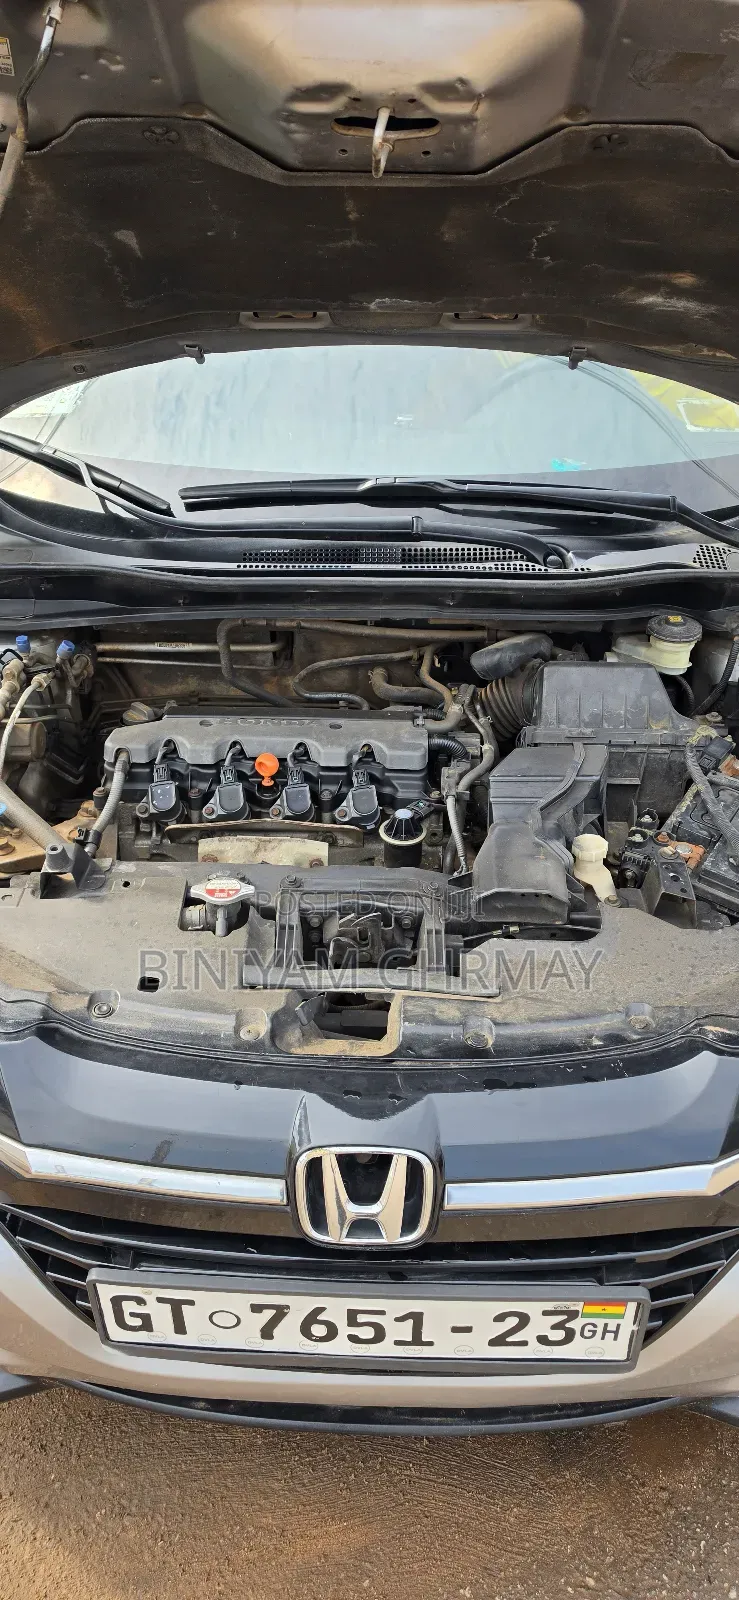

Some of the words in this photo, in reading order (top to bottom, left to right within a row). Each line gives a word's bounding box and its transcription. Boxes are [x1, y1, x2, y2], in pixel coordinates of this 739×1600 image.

[110, 1295, 196, 1336] GT
[250, 1303, 435, 1348] 7651
[487, 1309, 581, 1348] 23
[579, 1322, 621, 1342] GH
